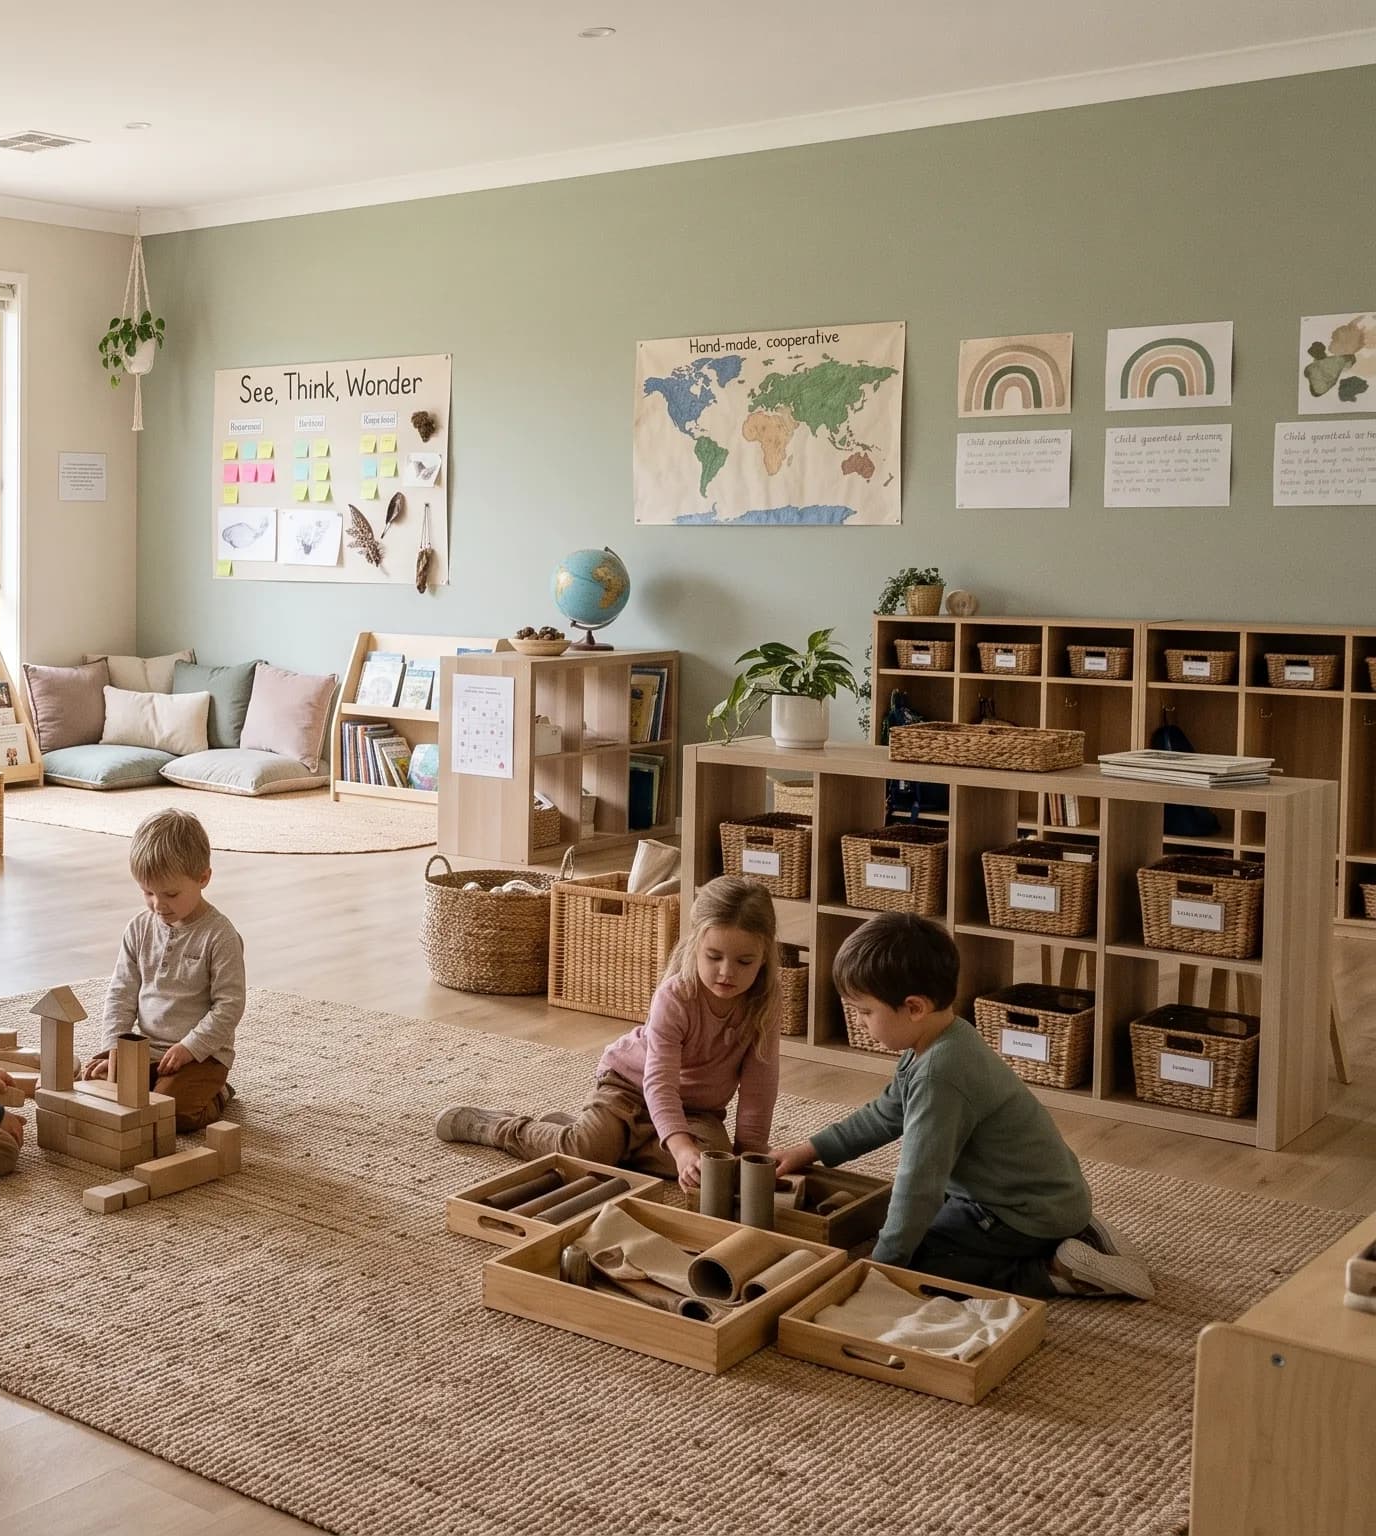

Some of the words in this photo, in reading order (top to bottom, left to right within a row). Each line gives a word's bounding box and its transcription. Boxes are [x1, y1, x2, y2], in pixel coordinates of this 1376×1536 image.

[689, 336, 761, 354] Hand-made,
[766, 329, 840, 352] cooperative
[239, 375, 278, 406] See,
[283, 370, 339, 402] Think,
[346, 366, 423, 397] Wonder
